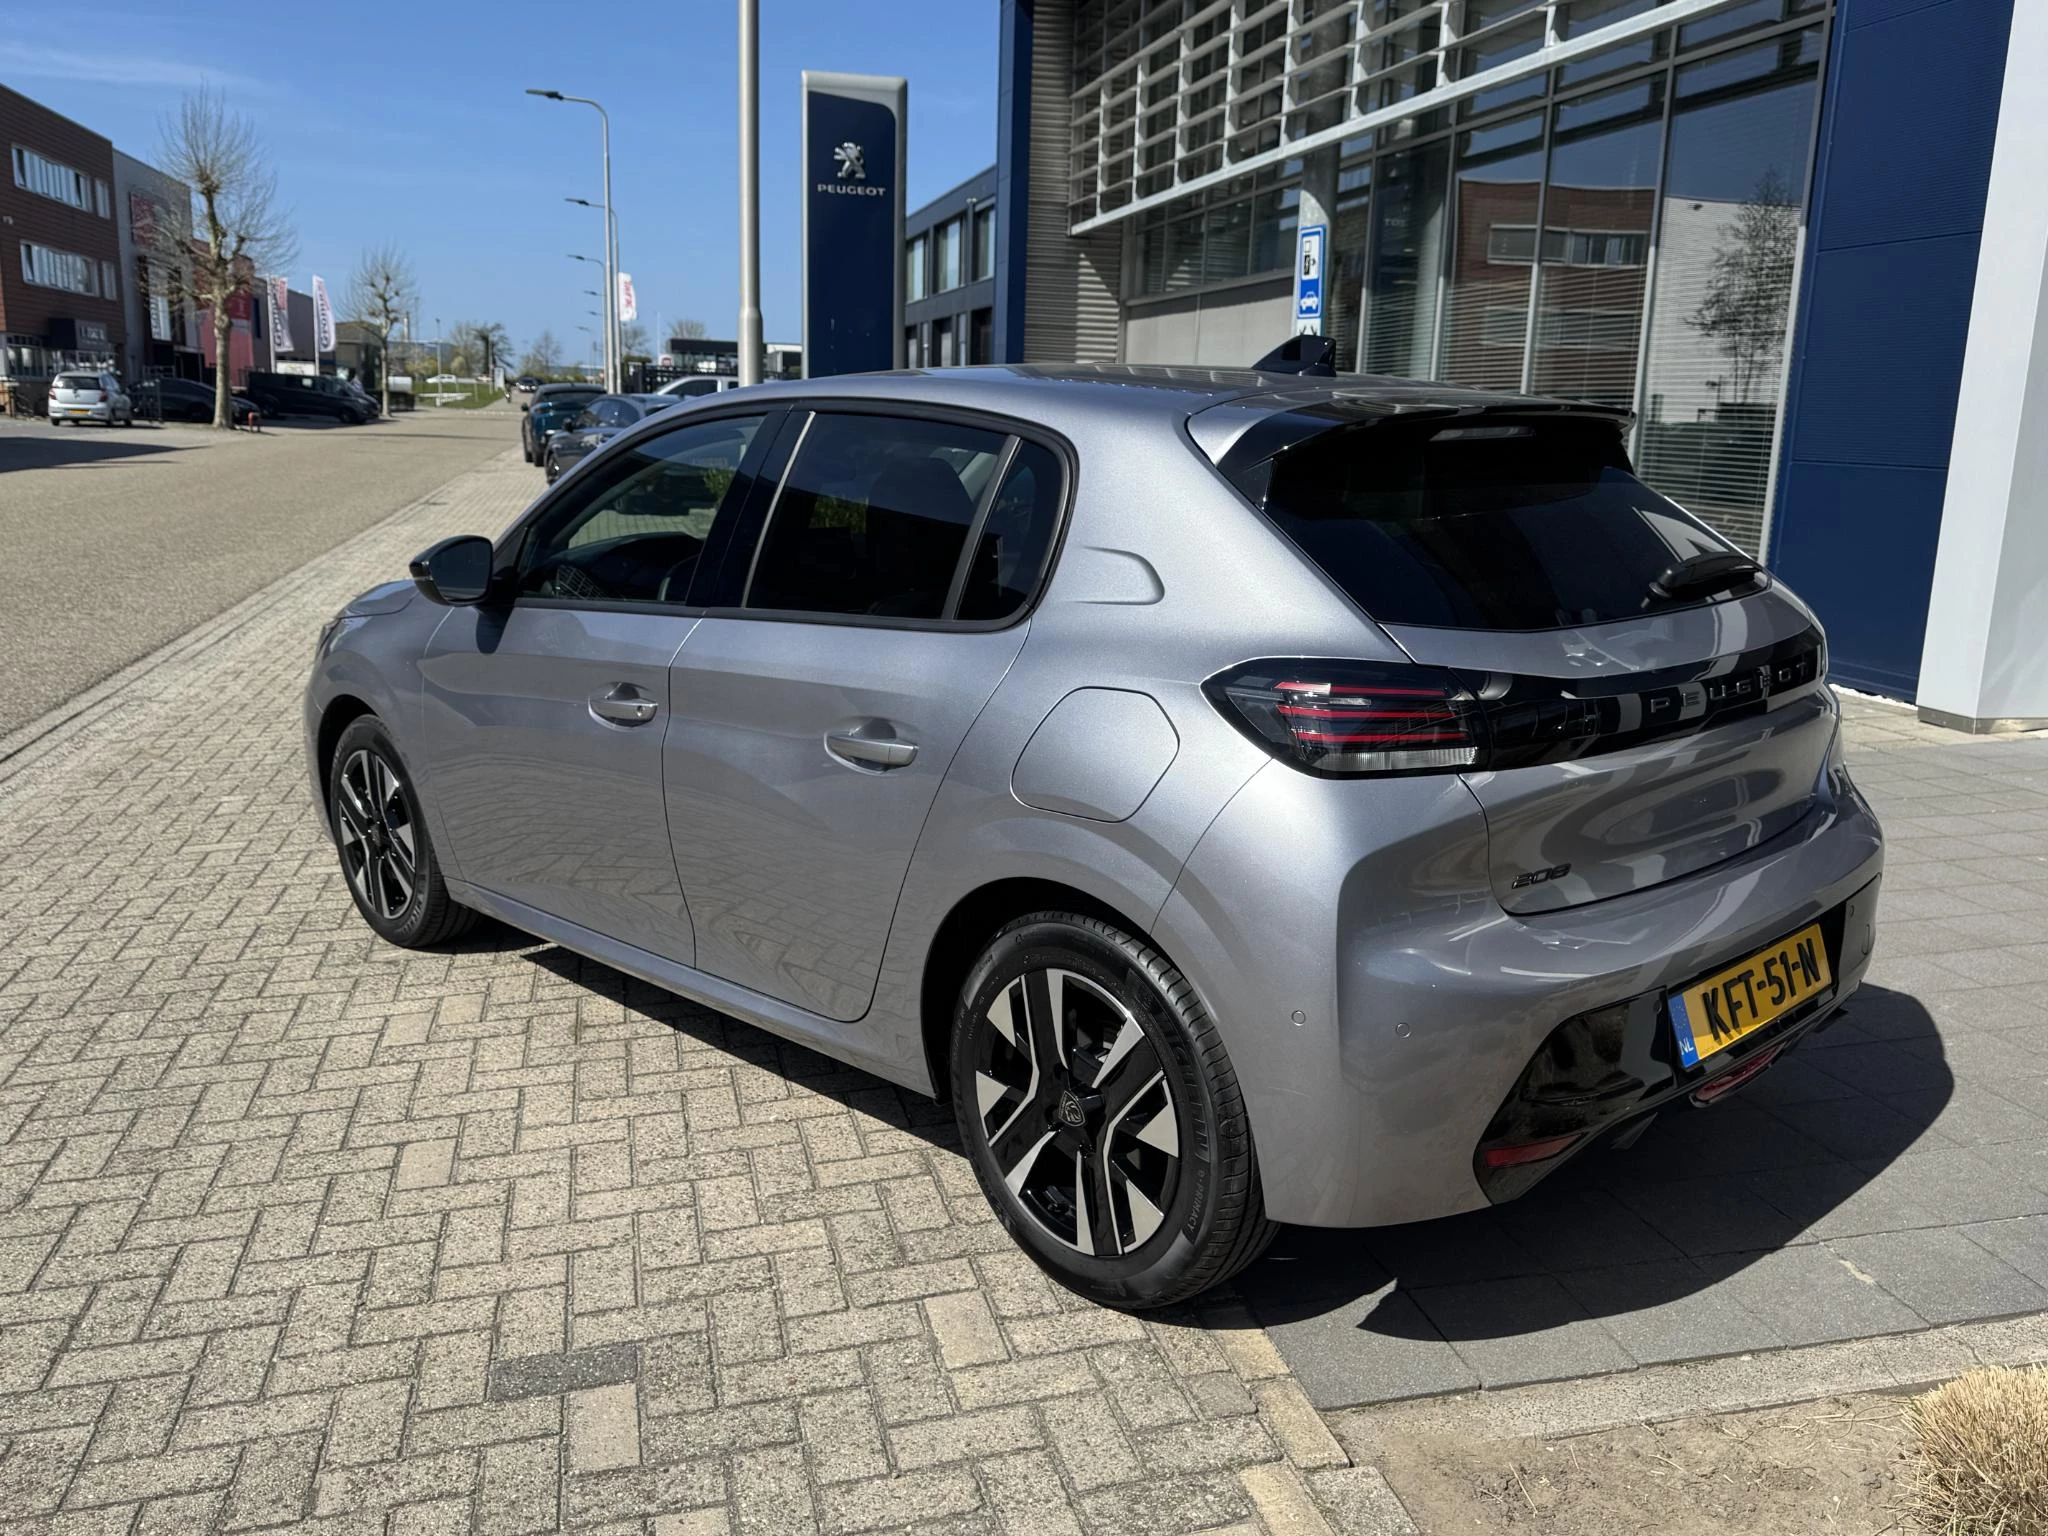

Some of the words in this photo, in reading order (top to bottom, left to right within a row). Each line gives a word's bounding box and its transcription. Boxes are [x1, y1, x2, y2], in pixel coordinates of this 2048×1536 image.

[817, 184, 886, 196] PEUGEOT
[1650, 661, 1808, 713] PEUGEOT
[1512, 863, 1571, 889] 208
[1702, 938, 1821, 1044] KFT-51-N
[1679, 1039, 1694, 1056] NL
